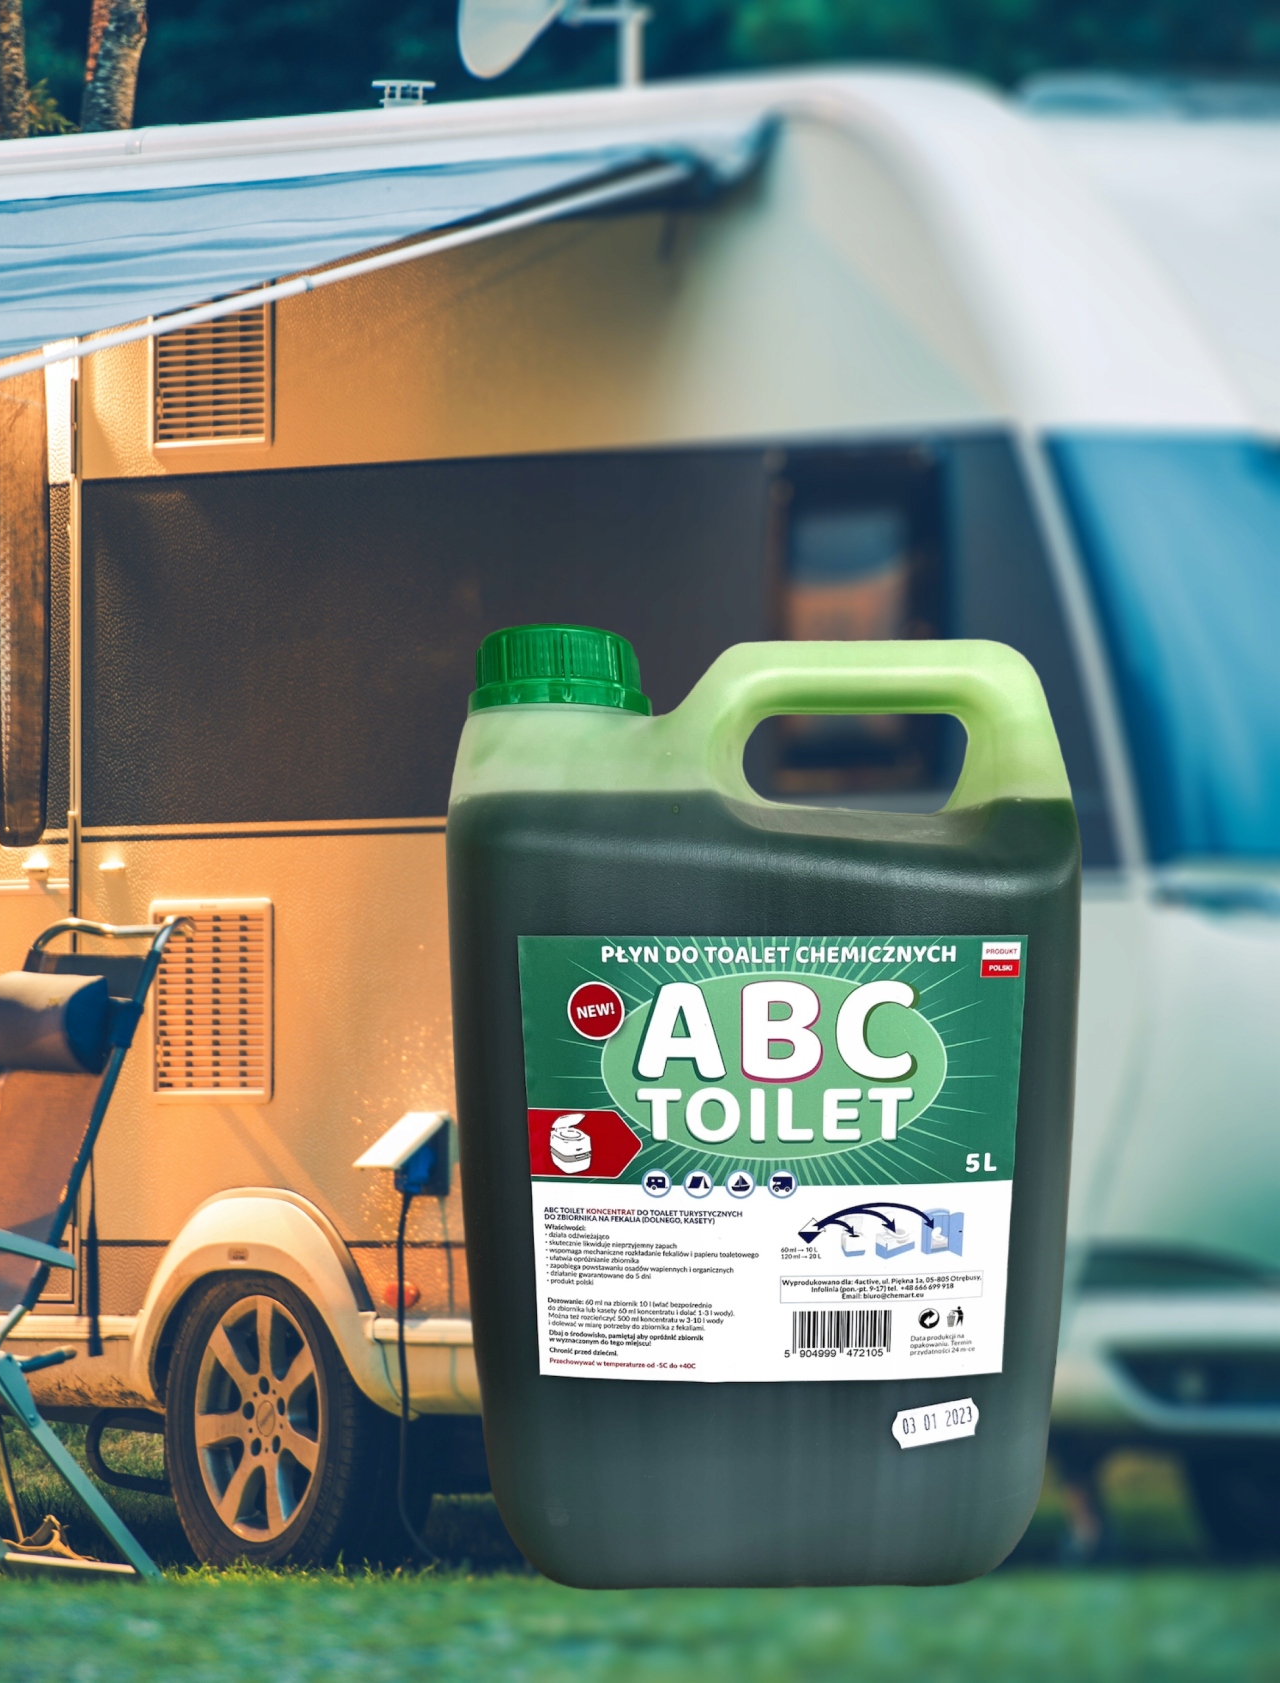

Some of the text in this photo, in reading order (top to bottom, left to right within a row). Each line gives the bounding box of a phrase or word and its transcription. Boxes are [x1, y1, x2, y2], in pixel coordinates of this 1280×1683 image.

[601, 945, 956, 964] PŁYN DO TOALET CHEMICZNYCH
[989, 964, 1013, 972] POLSKI
[576, 1002, 615, 1020] NEW!
[631, 979, 920, 1084] ABC
[635, 1086, 915, 1144] TOILET
[965, 1152, 997, 1173] 5 L
[679, 1210, 743, 1218] TURYSTYCZNYCH
[557, 1214, 597, 1222] ZBIORNIKA
[642, 1216, 683, 1225] (DOLNEGO,
[684, 1217, 715, 1225] KASETY)
[544, 1223, 586, 1231] Właściwości:
[612, 1242, 654, 1250] nieprzyjemny
[694, 1251, 718, 1259] papieru
[582, 1264, 623, 1272] powstawaniu
[650, 1266, 688, 1274] wapiennych
[782, 1279, 840, 1287] Wyprodukowano
[548, 1297, 584, 1305] Dozowanie:
[557, 1305, 585, 1313] zbiornika
[637, 1308, 675, 1316] koncentratu
[549, 1329, 563, 1337] Dbaj
[570, 1330, 607, 1339] środowisko,
[926, 1334, 956, 1342] produkcji
[783, 1348, 884, 1358] 5 904999 472105
[910, 1347, 950, 1356] przydatności
[549, 1357, 595, 1366] Przechowywać
[902, 1406, 972, 1435] 03 01 2023
